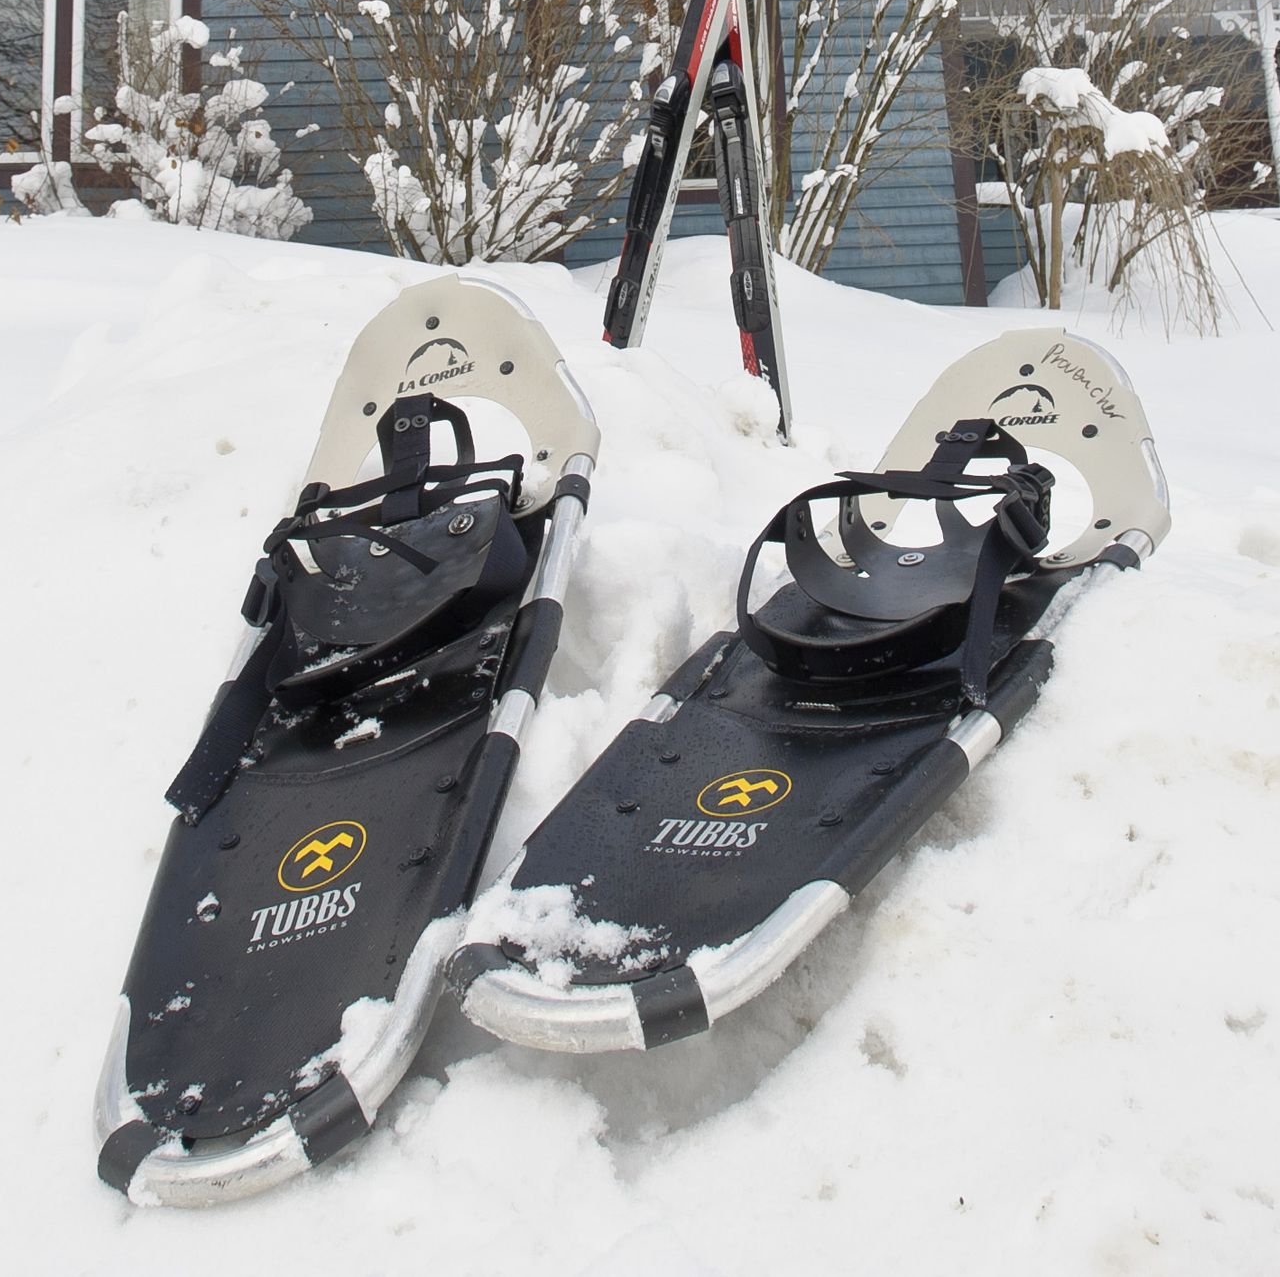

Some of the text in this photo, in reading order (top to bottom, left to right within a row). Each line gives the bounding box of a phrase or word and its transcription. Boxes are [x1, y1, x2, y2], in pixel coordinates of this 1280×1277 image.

[397, 360, 476, 394] LA CORDÉE
[1041, 343, 1128, 420] Provencher
[998, 412, 1061, 427] CORDÉE
[650, 818, 769, 848] TUBBS
[643, 845, 743, 857] SNOWSHOES
[250, 882, 362, 943] TUBBS
[246, 920, 348, 954] SNOWSHOES
